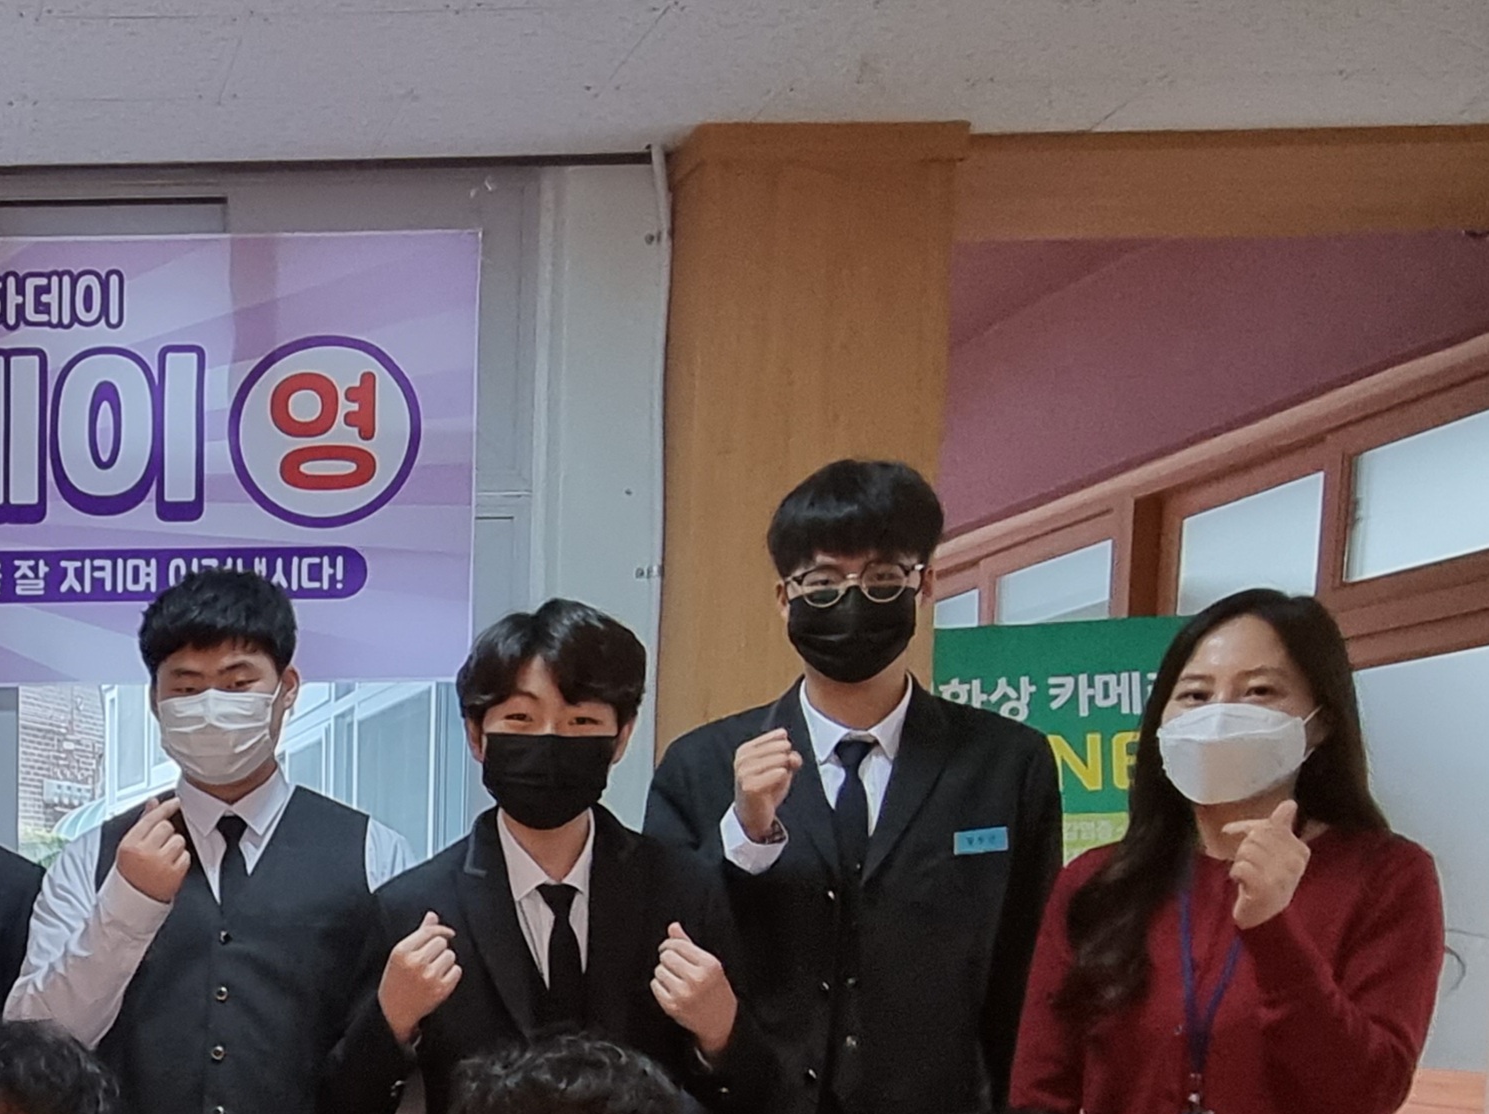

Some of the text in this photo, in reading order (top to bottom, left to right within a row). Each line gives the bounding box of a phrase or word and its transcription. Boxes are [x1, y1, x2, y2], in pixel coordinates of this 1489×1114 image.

[270, 370, 377, 492] 영
[12, 558, 50, 597] 잘
[59, 557, 158, 594] 지키며
[1047, 671, 1158, 718] 카메
